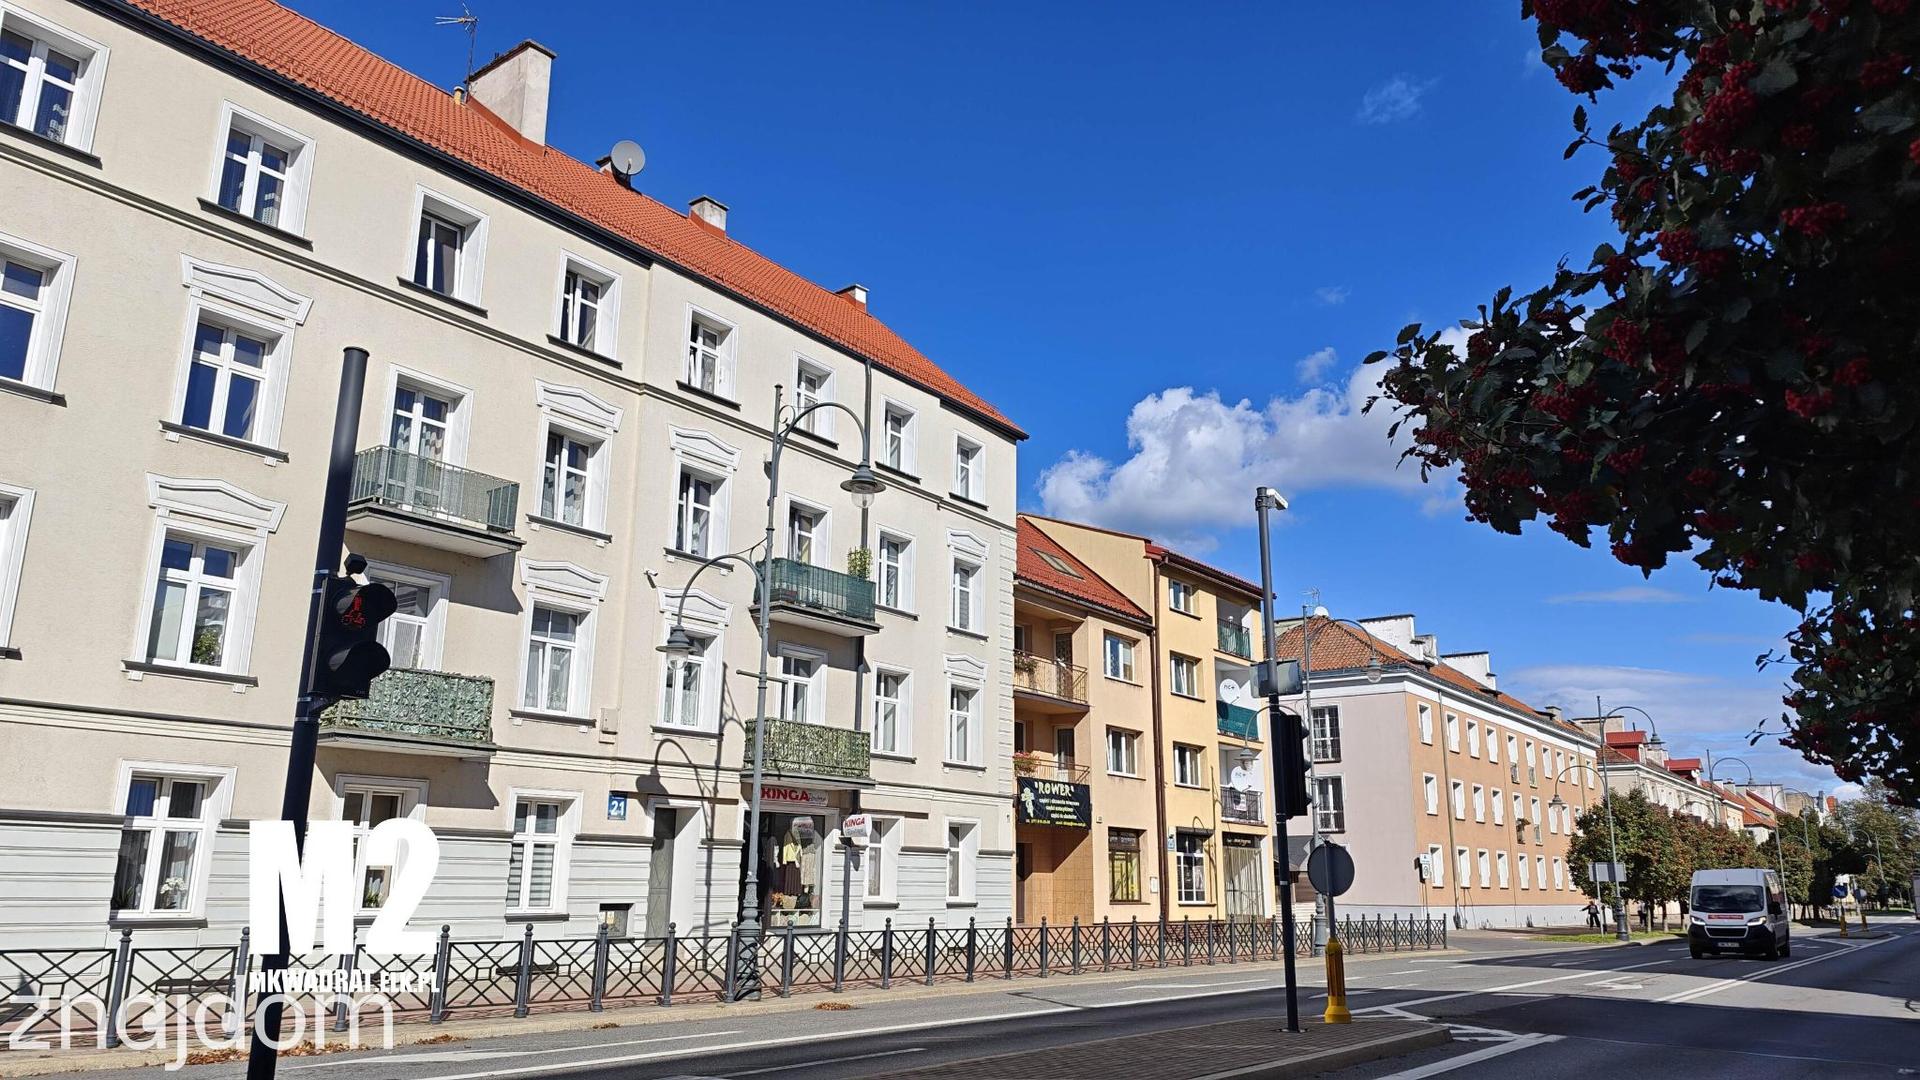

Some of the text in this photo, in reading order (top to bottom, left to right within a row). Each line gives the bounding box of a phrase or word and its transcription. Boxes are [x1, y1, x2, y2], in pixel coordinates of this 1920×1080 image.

[760, 787, 810, 802] KINGA
[610, 800, 625, 816] 21
[843, 816, 866, 830] KINGA
